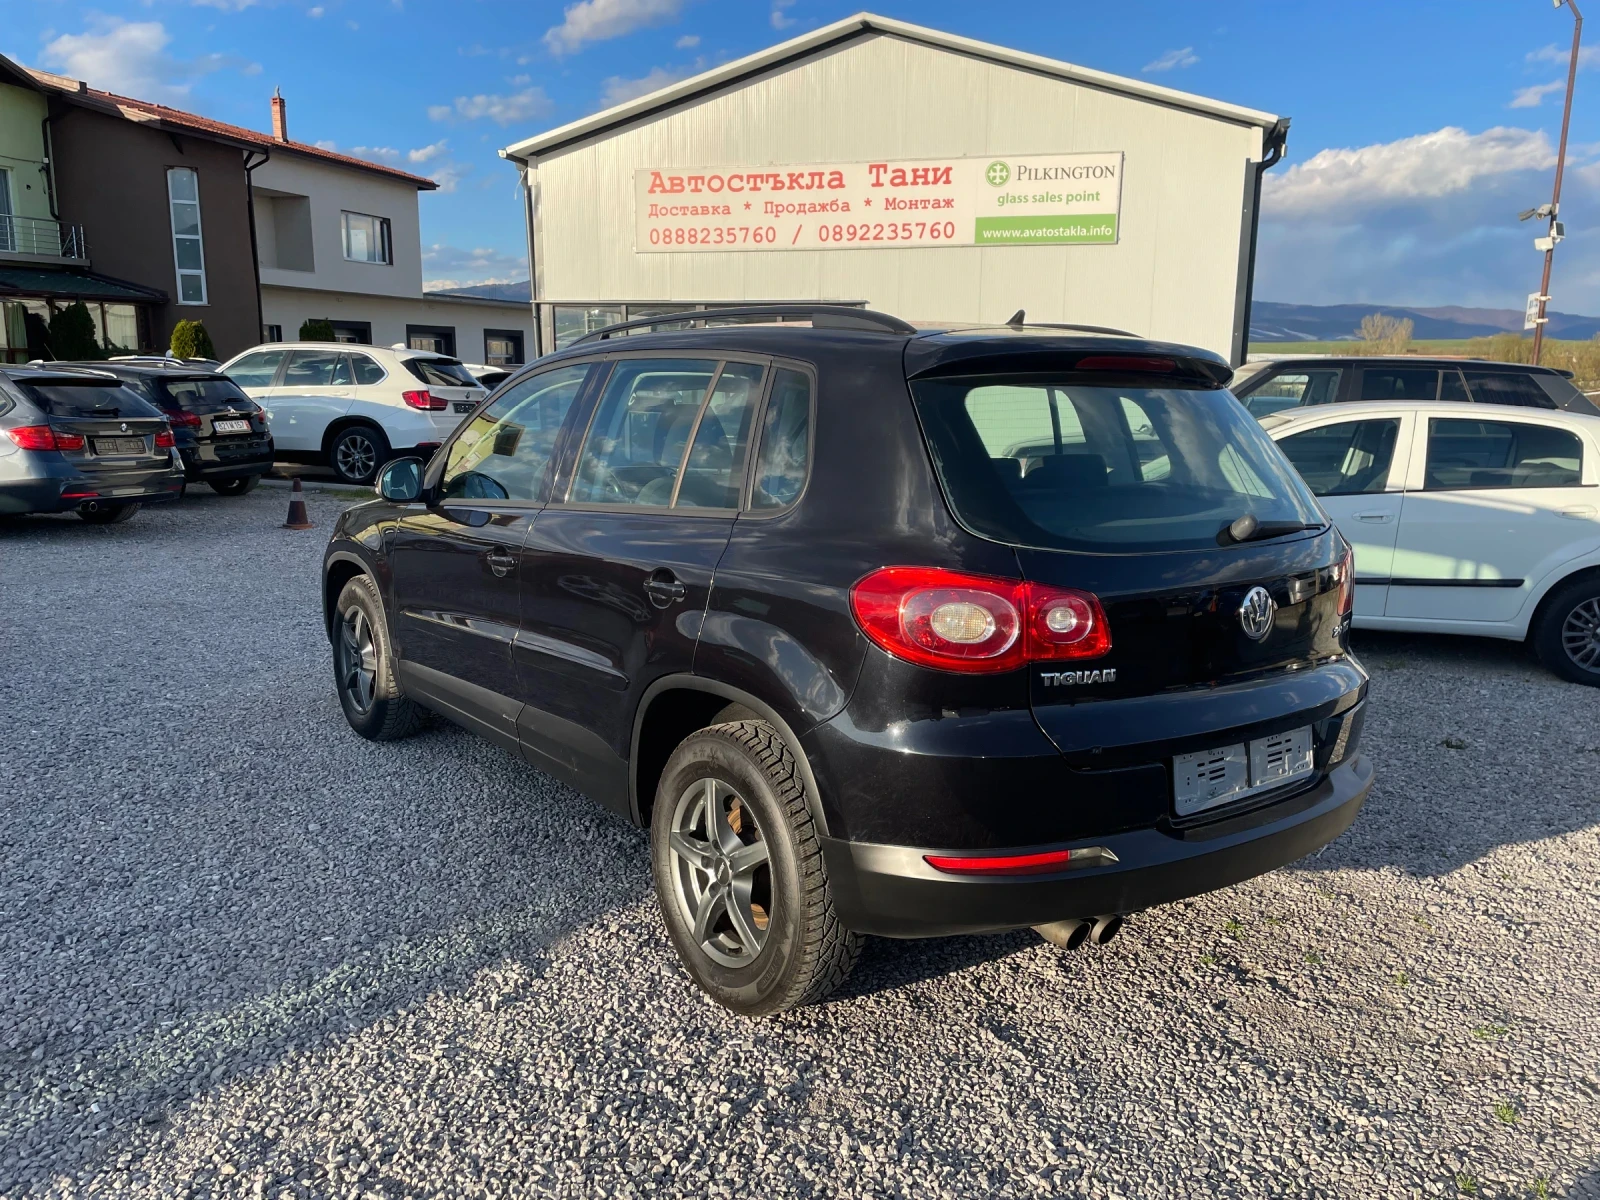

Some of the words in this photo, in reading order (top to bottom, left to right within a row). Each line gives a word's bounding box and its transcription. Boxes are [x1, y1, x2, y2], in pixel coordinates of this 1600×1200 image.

[648, 170, 846, 194] Автостъкла
[868, 163, 953, 188] Тани
[1016, 164, 1116, 182] PILKINGTON
[648, 203, 732, 219] Доставка
[763, 199, 851, 218] Продажба
[884, 197, 955, 211] Монтаж
[997, 192, 1029, 207] glass
[1032, 191, 1063, 204] sales
[1066, 190, 1101, 205] point
[649, 226, 777, 245] 0888235760
[818, 221, 955, 242] 0892235760
[1040, 668, 1117, 687] TIGUAN
